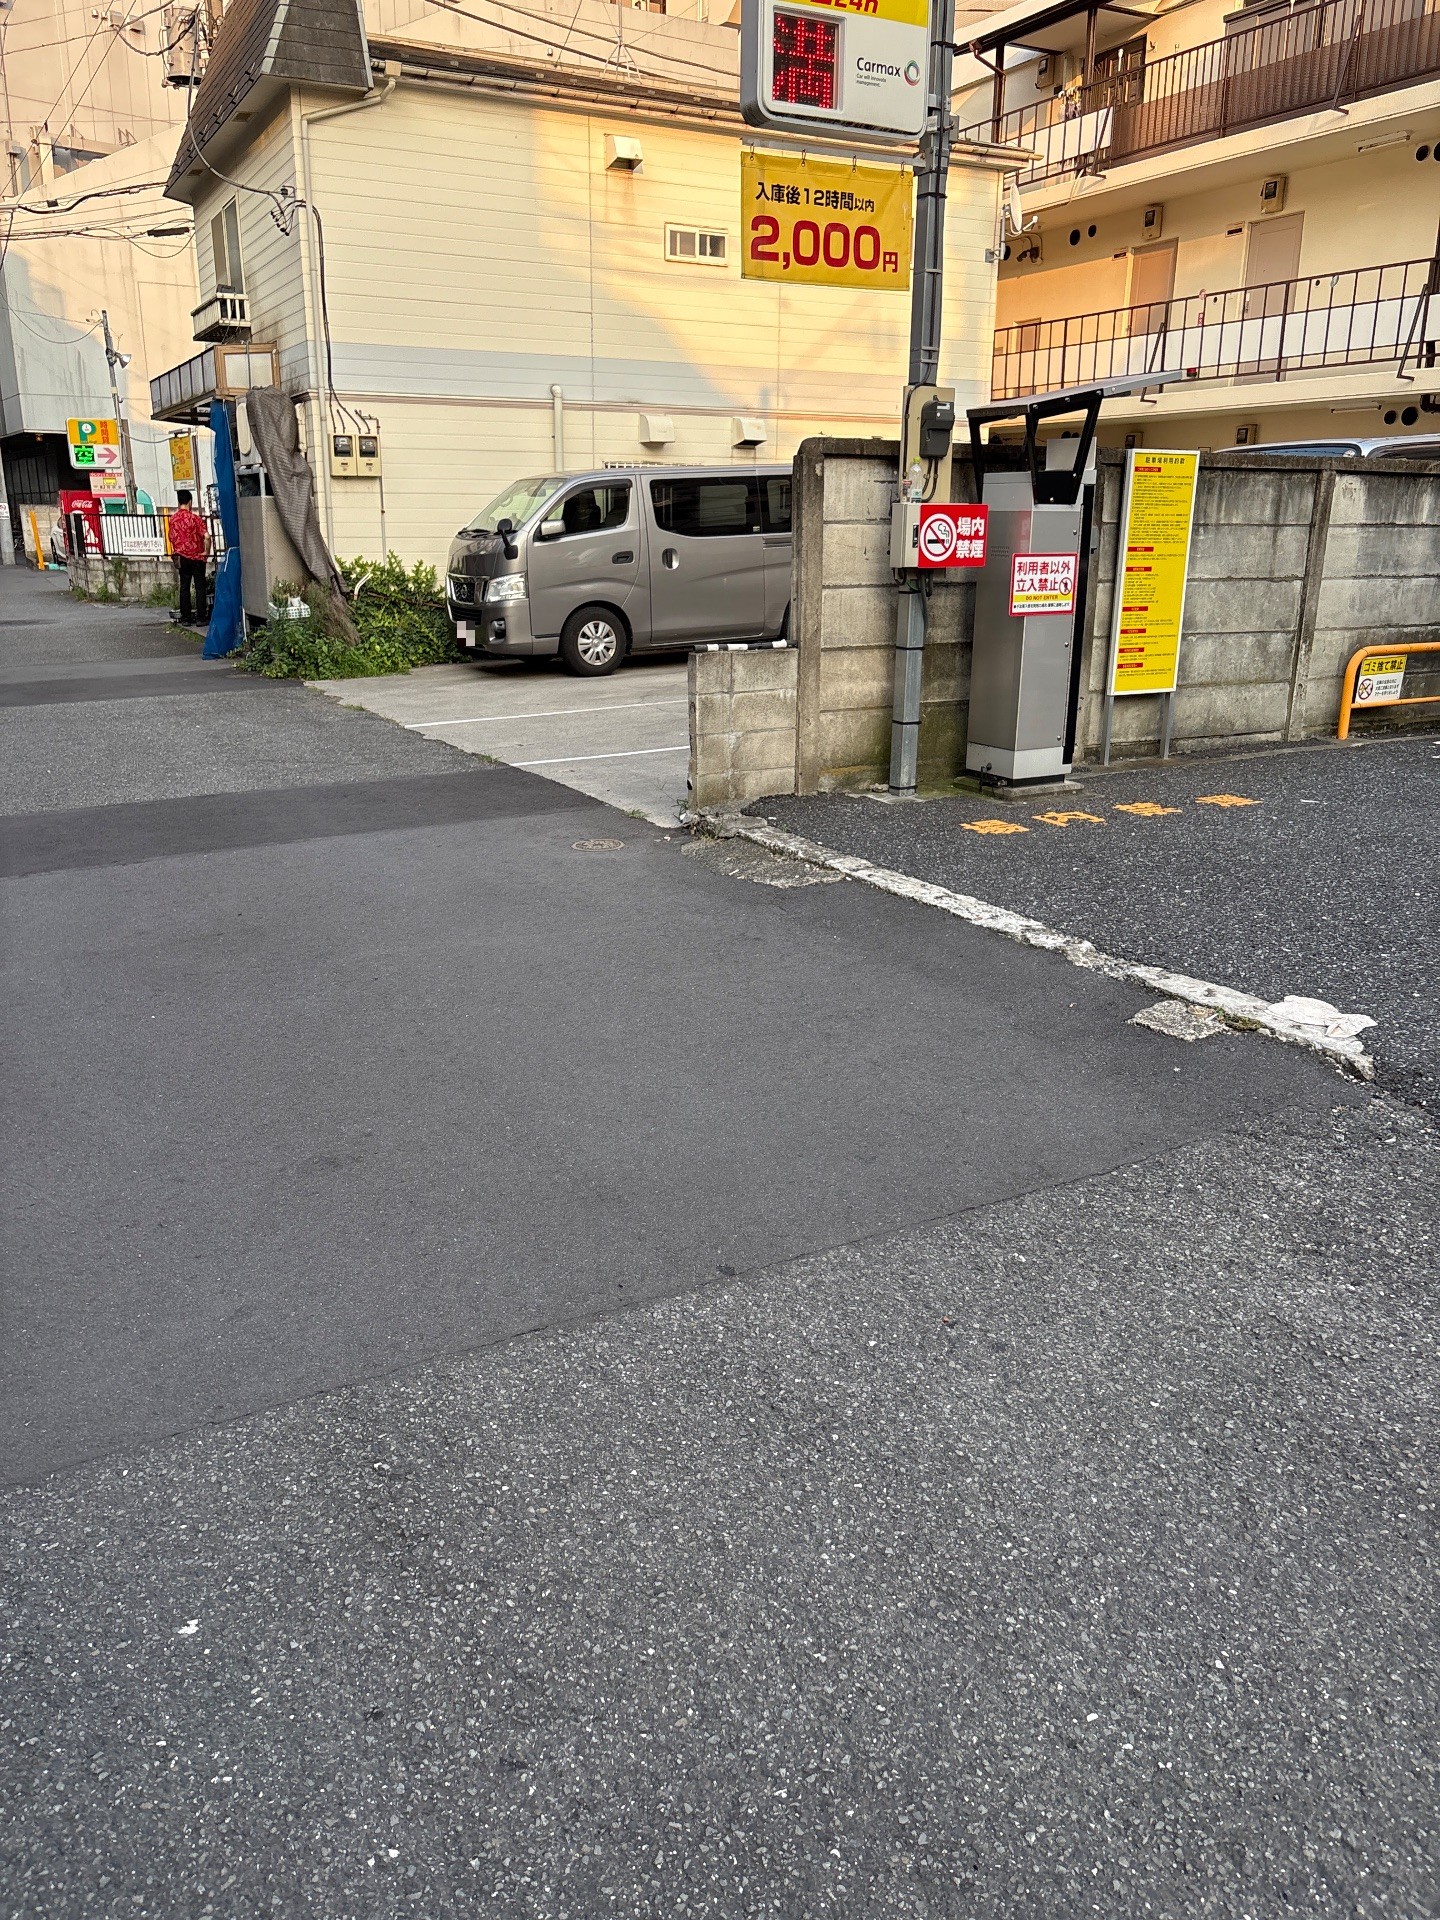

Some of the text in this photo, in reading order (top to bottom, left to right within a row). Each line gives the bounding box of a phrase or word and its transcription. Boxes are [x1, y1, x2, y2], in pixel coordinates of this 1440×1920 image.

[856, 57, 901, 77] Carmax
[755, 182, 875, 212] 入庫後12時間以内
[750, 215, 899, 273] 2,000円
[956, 517, 985, 536] 場内
[955, 540, 984, 558] 禁煙
[1016, 561, 1071, 576] 利用者以外
[1015, 577, 1059, 593] 立入禁止
[1364, 659, 1404, 672] ゴミ捨て禁止
